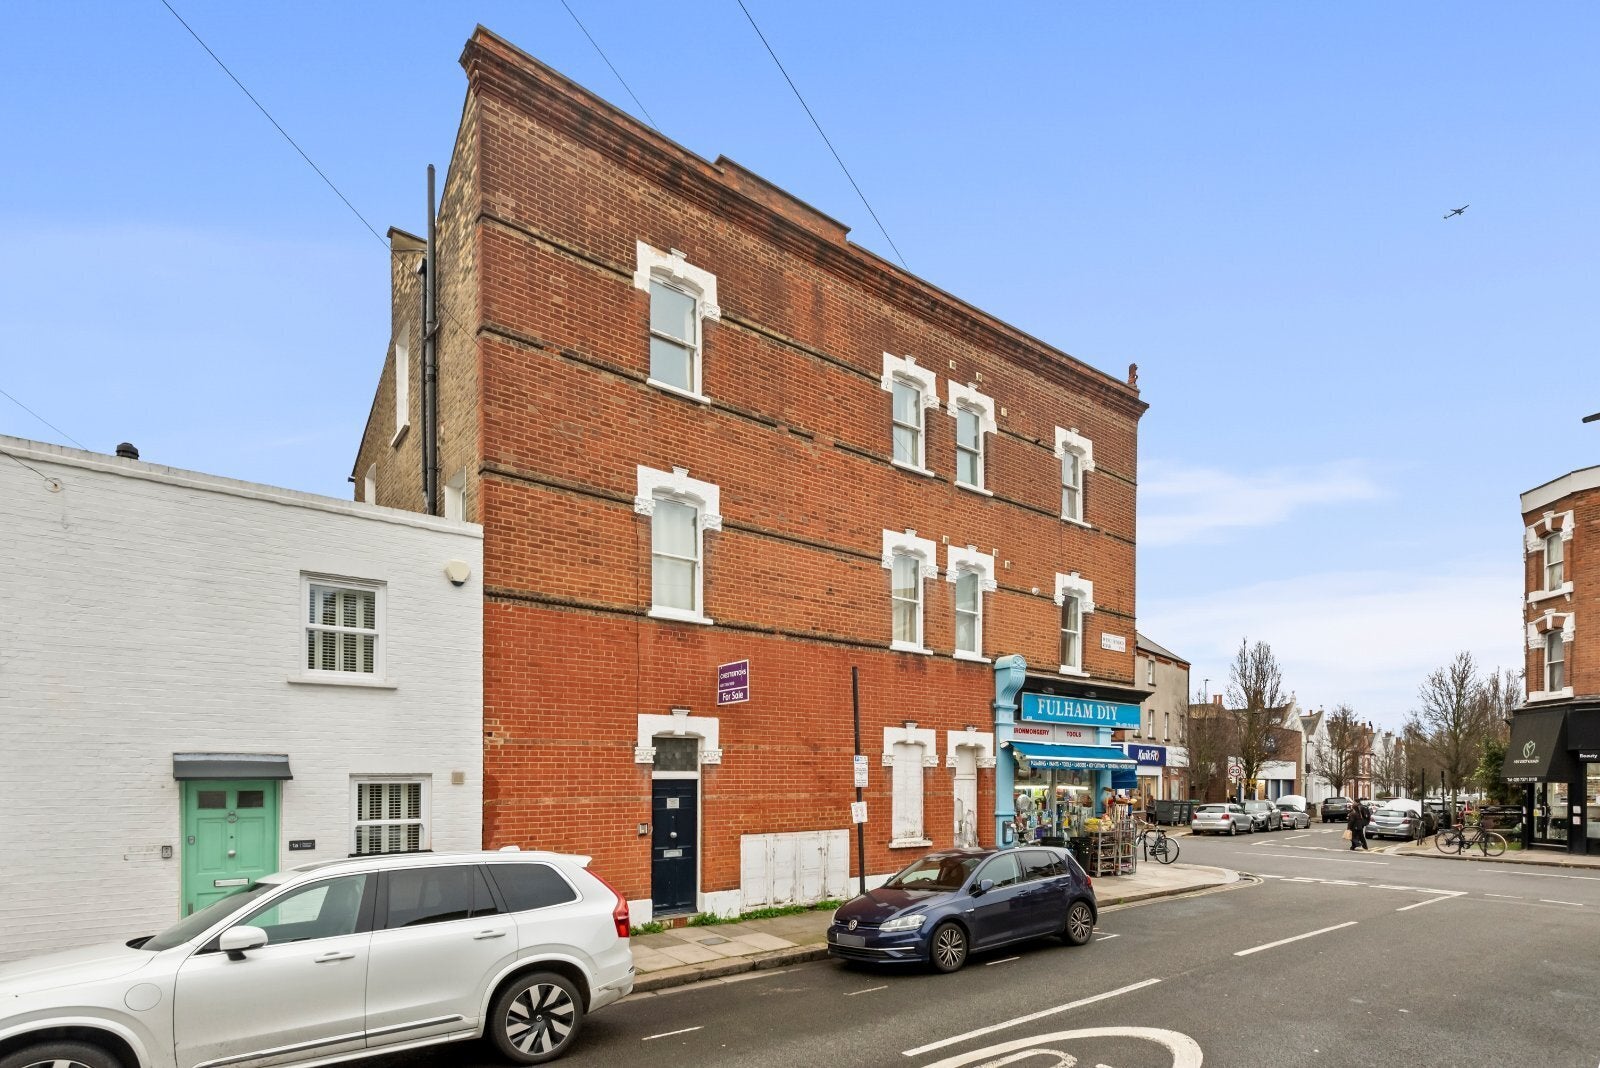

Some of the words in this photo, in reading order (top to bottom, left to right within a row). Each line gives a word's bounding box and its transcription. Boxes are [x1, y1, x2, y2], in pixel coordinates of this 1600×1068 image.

[722, 692, 731, 701] For
[732, 690, 743, 700] Sale
[1037, 698, 1093, 719] FULHAM
[1097, 705, 1118, 720] DIY
[1013, 727, 1049, 736] IRONMONGERY
